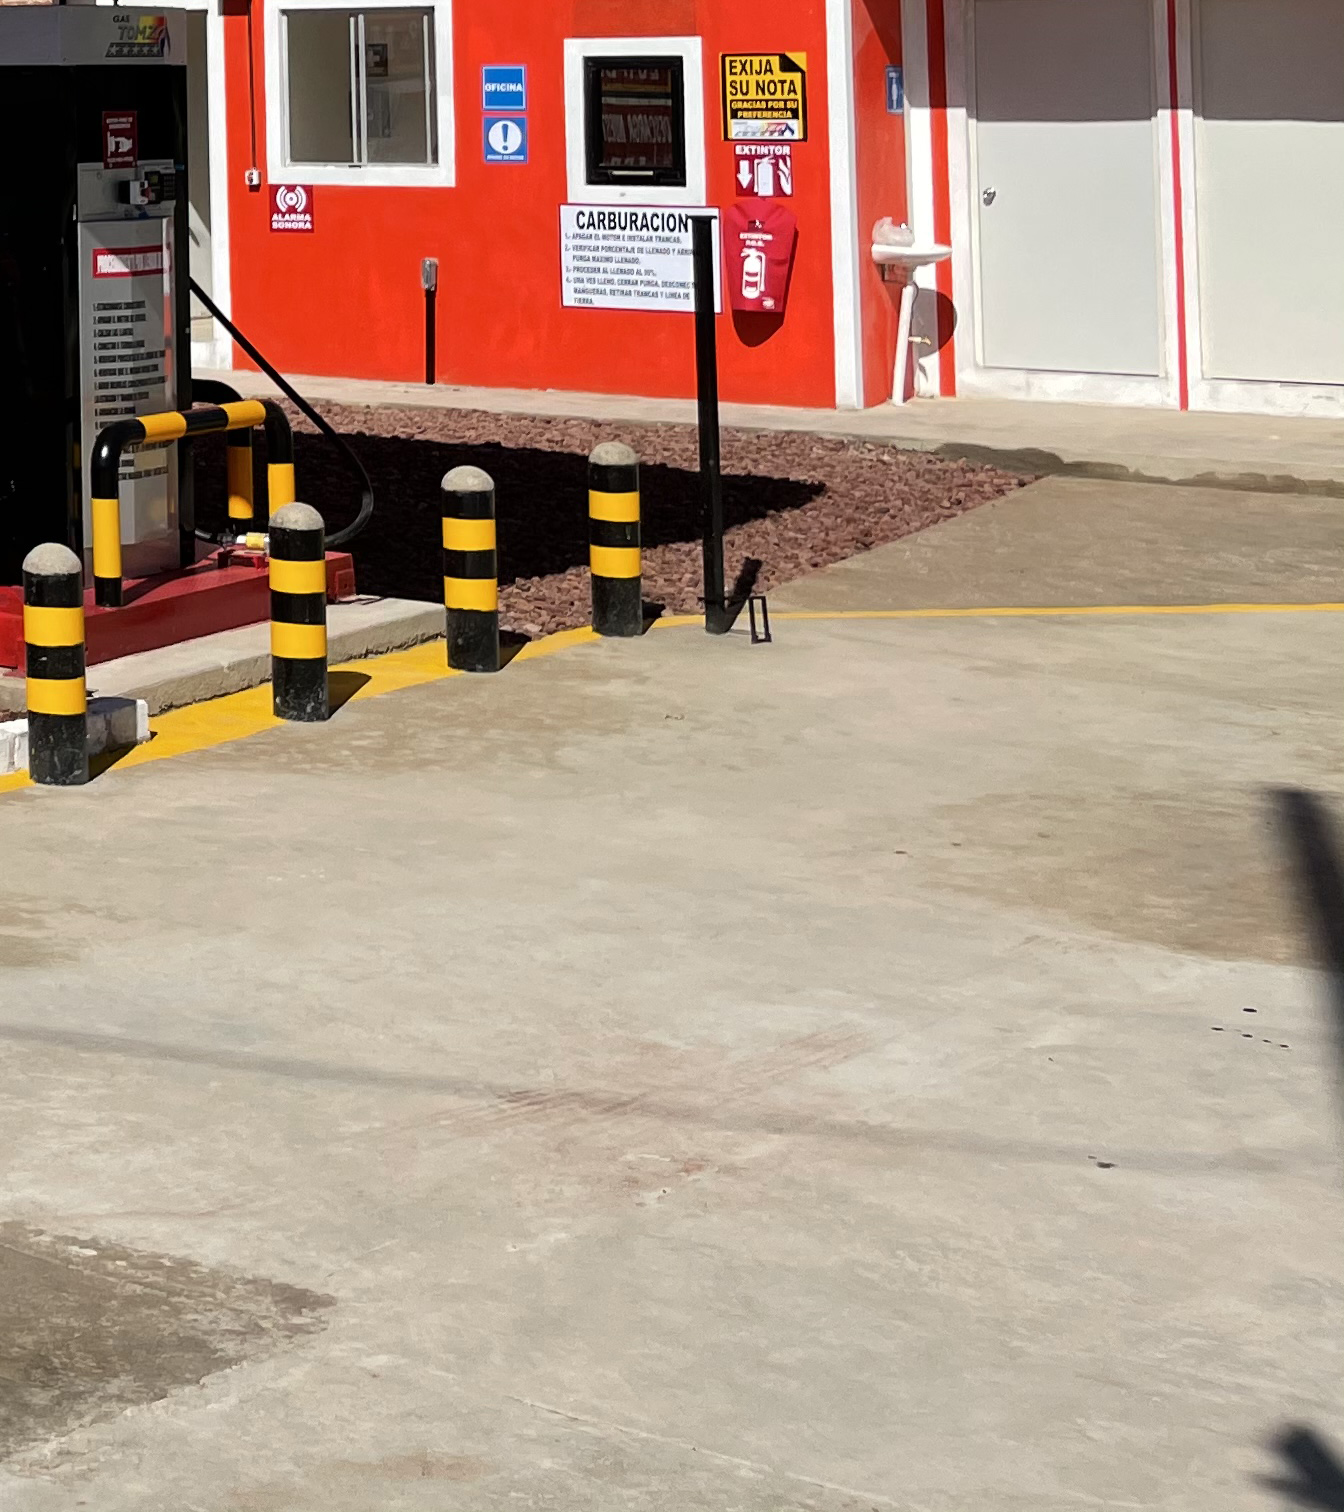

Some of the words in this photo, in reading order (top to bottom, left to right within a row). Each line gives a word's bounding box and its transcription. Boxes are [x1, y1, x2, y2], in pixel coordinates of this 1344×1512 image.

[729, 58, 773, 75] EXIJA
[484, 82, 523, 92] OFICINA
[729, 80, 749, 96] SU
[755, 80, 798, 96] NOTA
[735, 144, 791, 155] EXTINTOR
[576, 211, 688, 233] CARBURACION
